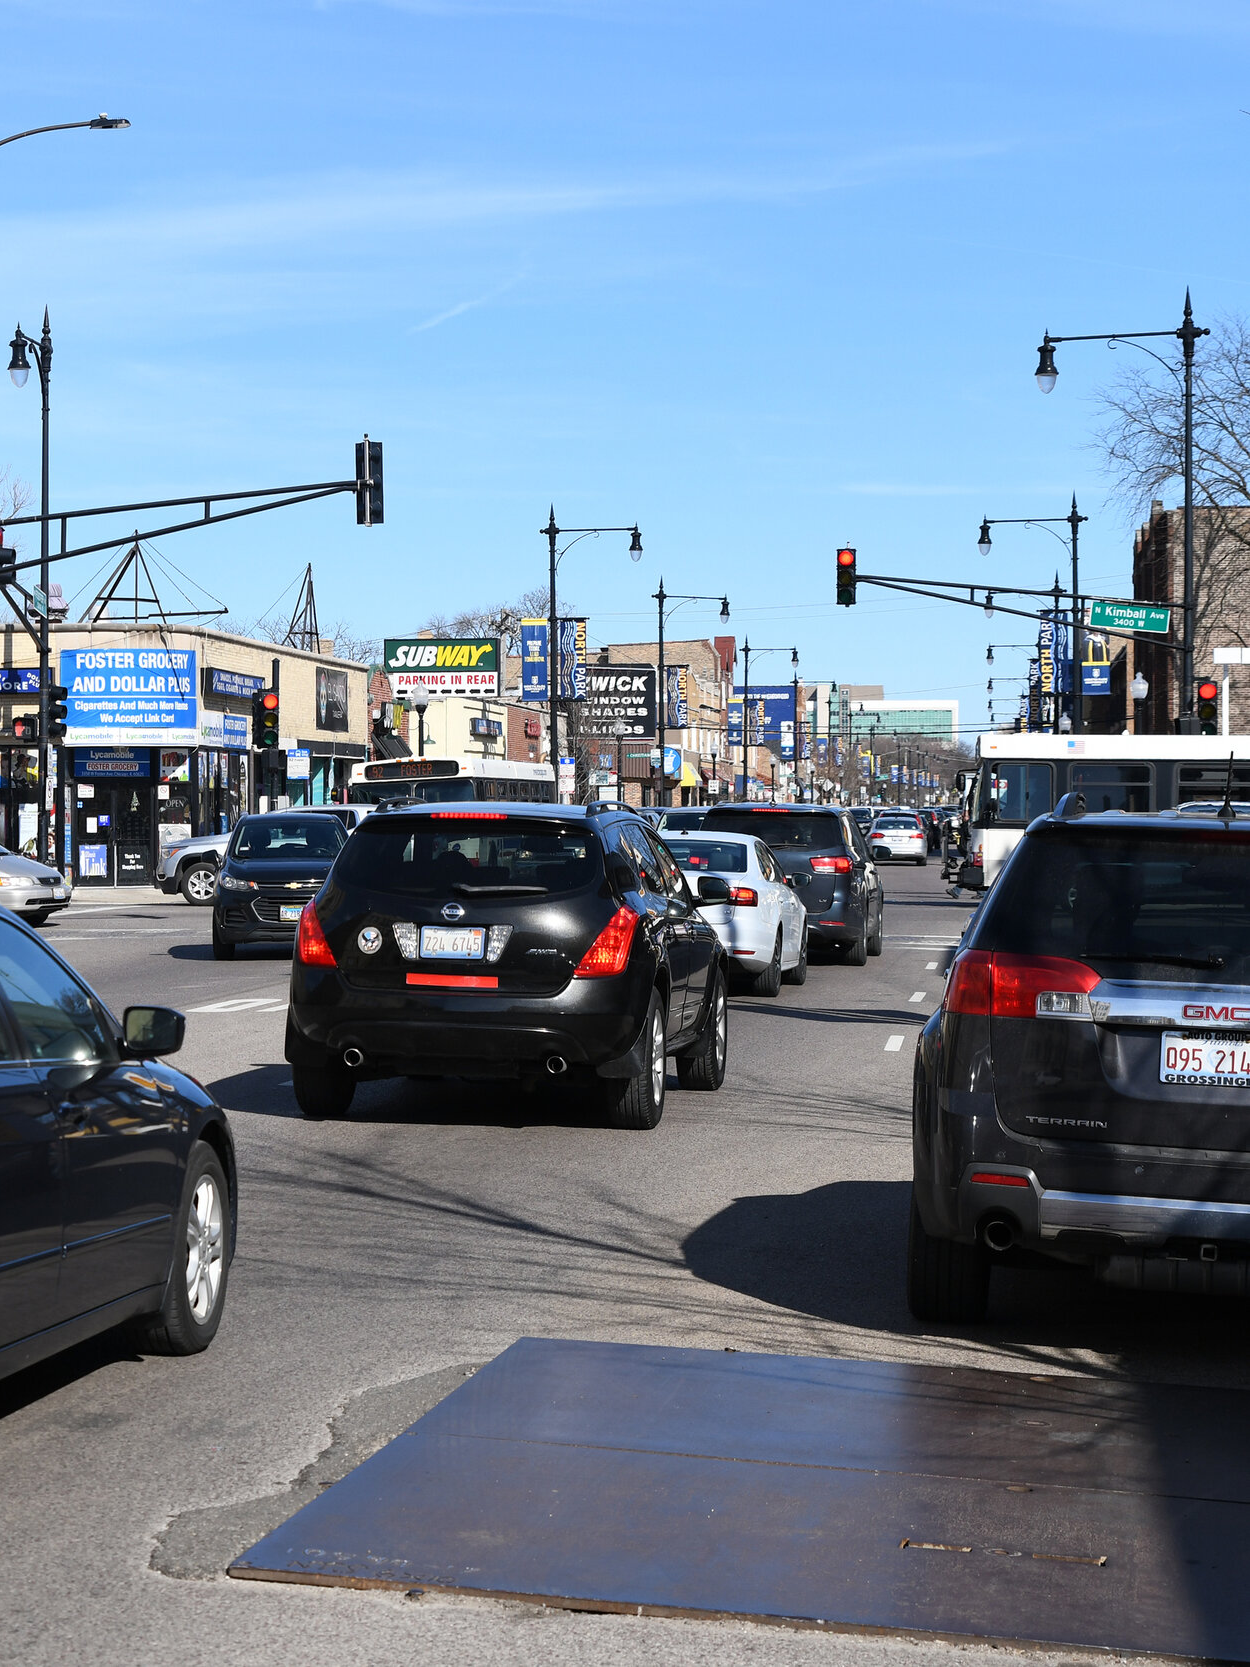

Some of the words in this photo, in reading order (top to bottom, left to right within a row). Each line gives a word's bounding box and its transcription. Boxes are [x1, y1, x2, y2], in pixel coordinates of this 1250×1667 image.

[1105, 606, 1146, 619] Kimball
[1150, 611, 1165, 619] Ave
[1113, 618, 1134, 626] 3400
[575, 622, 586, 664] NORTH
[76, 652, 135, 669] FOSTER
[138, 653, 189, 669] GROCERY
[388, 643, 493, 668] SUBWAY
[1030, 661, 1039, 686] PARK
[1041, 648, 1053, 692] NORTH
[72, 676, 106, 693] AND
[110, 675, 166, 692] DOLLAR
[168, 676, 190, 693] PLUS
[398, 675, 446, 685] PARKING
[451, 675, 462, 685] IN
[467, 674, 495, 685] REAR
[575, 667, 586, 698] PARK
[678, 668, 688, 700] NORTH
[74, 700, 119, 712] Cigarettes
[121, 701, 137, 711] And
[137, 701, 159, 711] Much
[159, 701, 175, 711] More
[678, 702, 688, 726] PARK
[99, 713, 113, 723] We
[114, 713, 144, 724] Accept
[144, 713, 160, 723] Link
[161, 714, 175, 723] Card
[90, 750, 135, 760] Lycamobile
[372, 766, 384, 778] 92
[401, 763, 433, 777] FOSTER
[165, 799, 184, 808] OPEN
[85, 857, 107, 876] Link
[424, 936, 446, 952] Z24
[451, 936, 481, 952] 6745
[1182, 1004, 1250, 1021] GMC
[1187, 1031, 1212, 1041] AUTO
[1214, 1031, 1246, 1042] GROUP
[1166, 1046, 1203, 1072] Q95
[1025, 1115, 1108, 1129] TERRAIN
